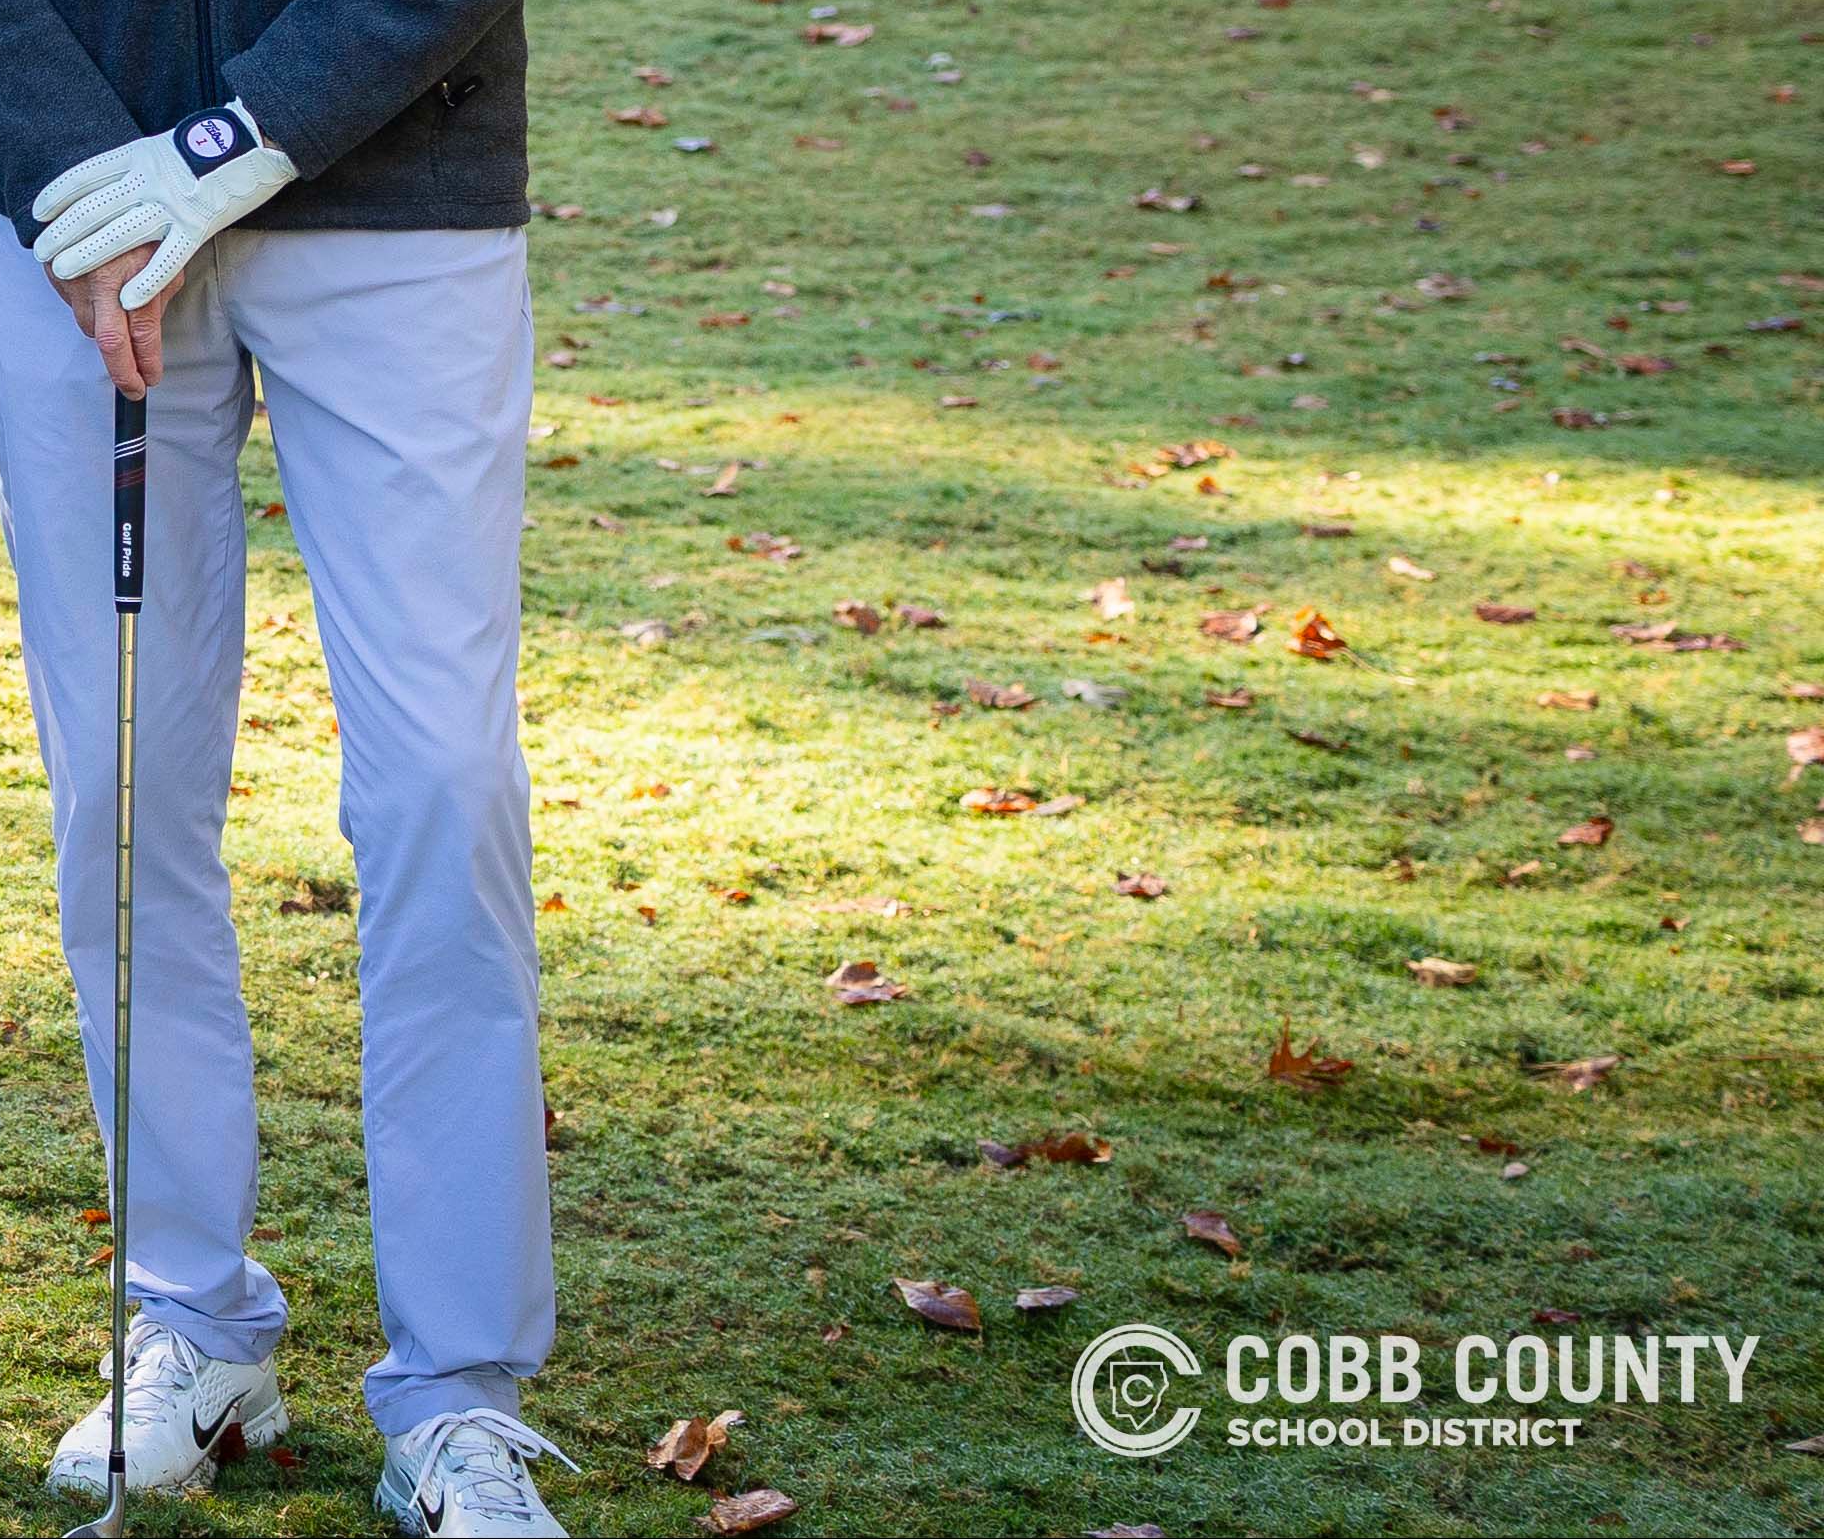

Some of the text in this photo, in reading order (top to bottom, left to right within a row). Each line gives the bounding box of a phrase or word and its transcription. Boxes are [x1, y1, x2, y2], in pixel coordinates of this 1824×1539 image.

[200, 119, 229, 153] Titleist
[122, 522, 132, 578] Golf Pride
